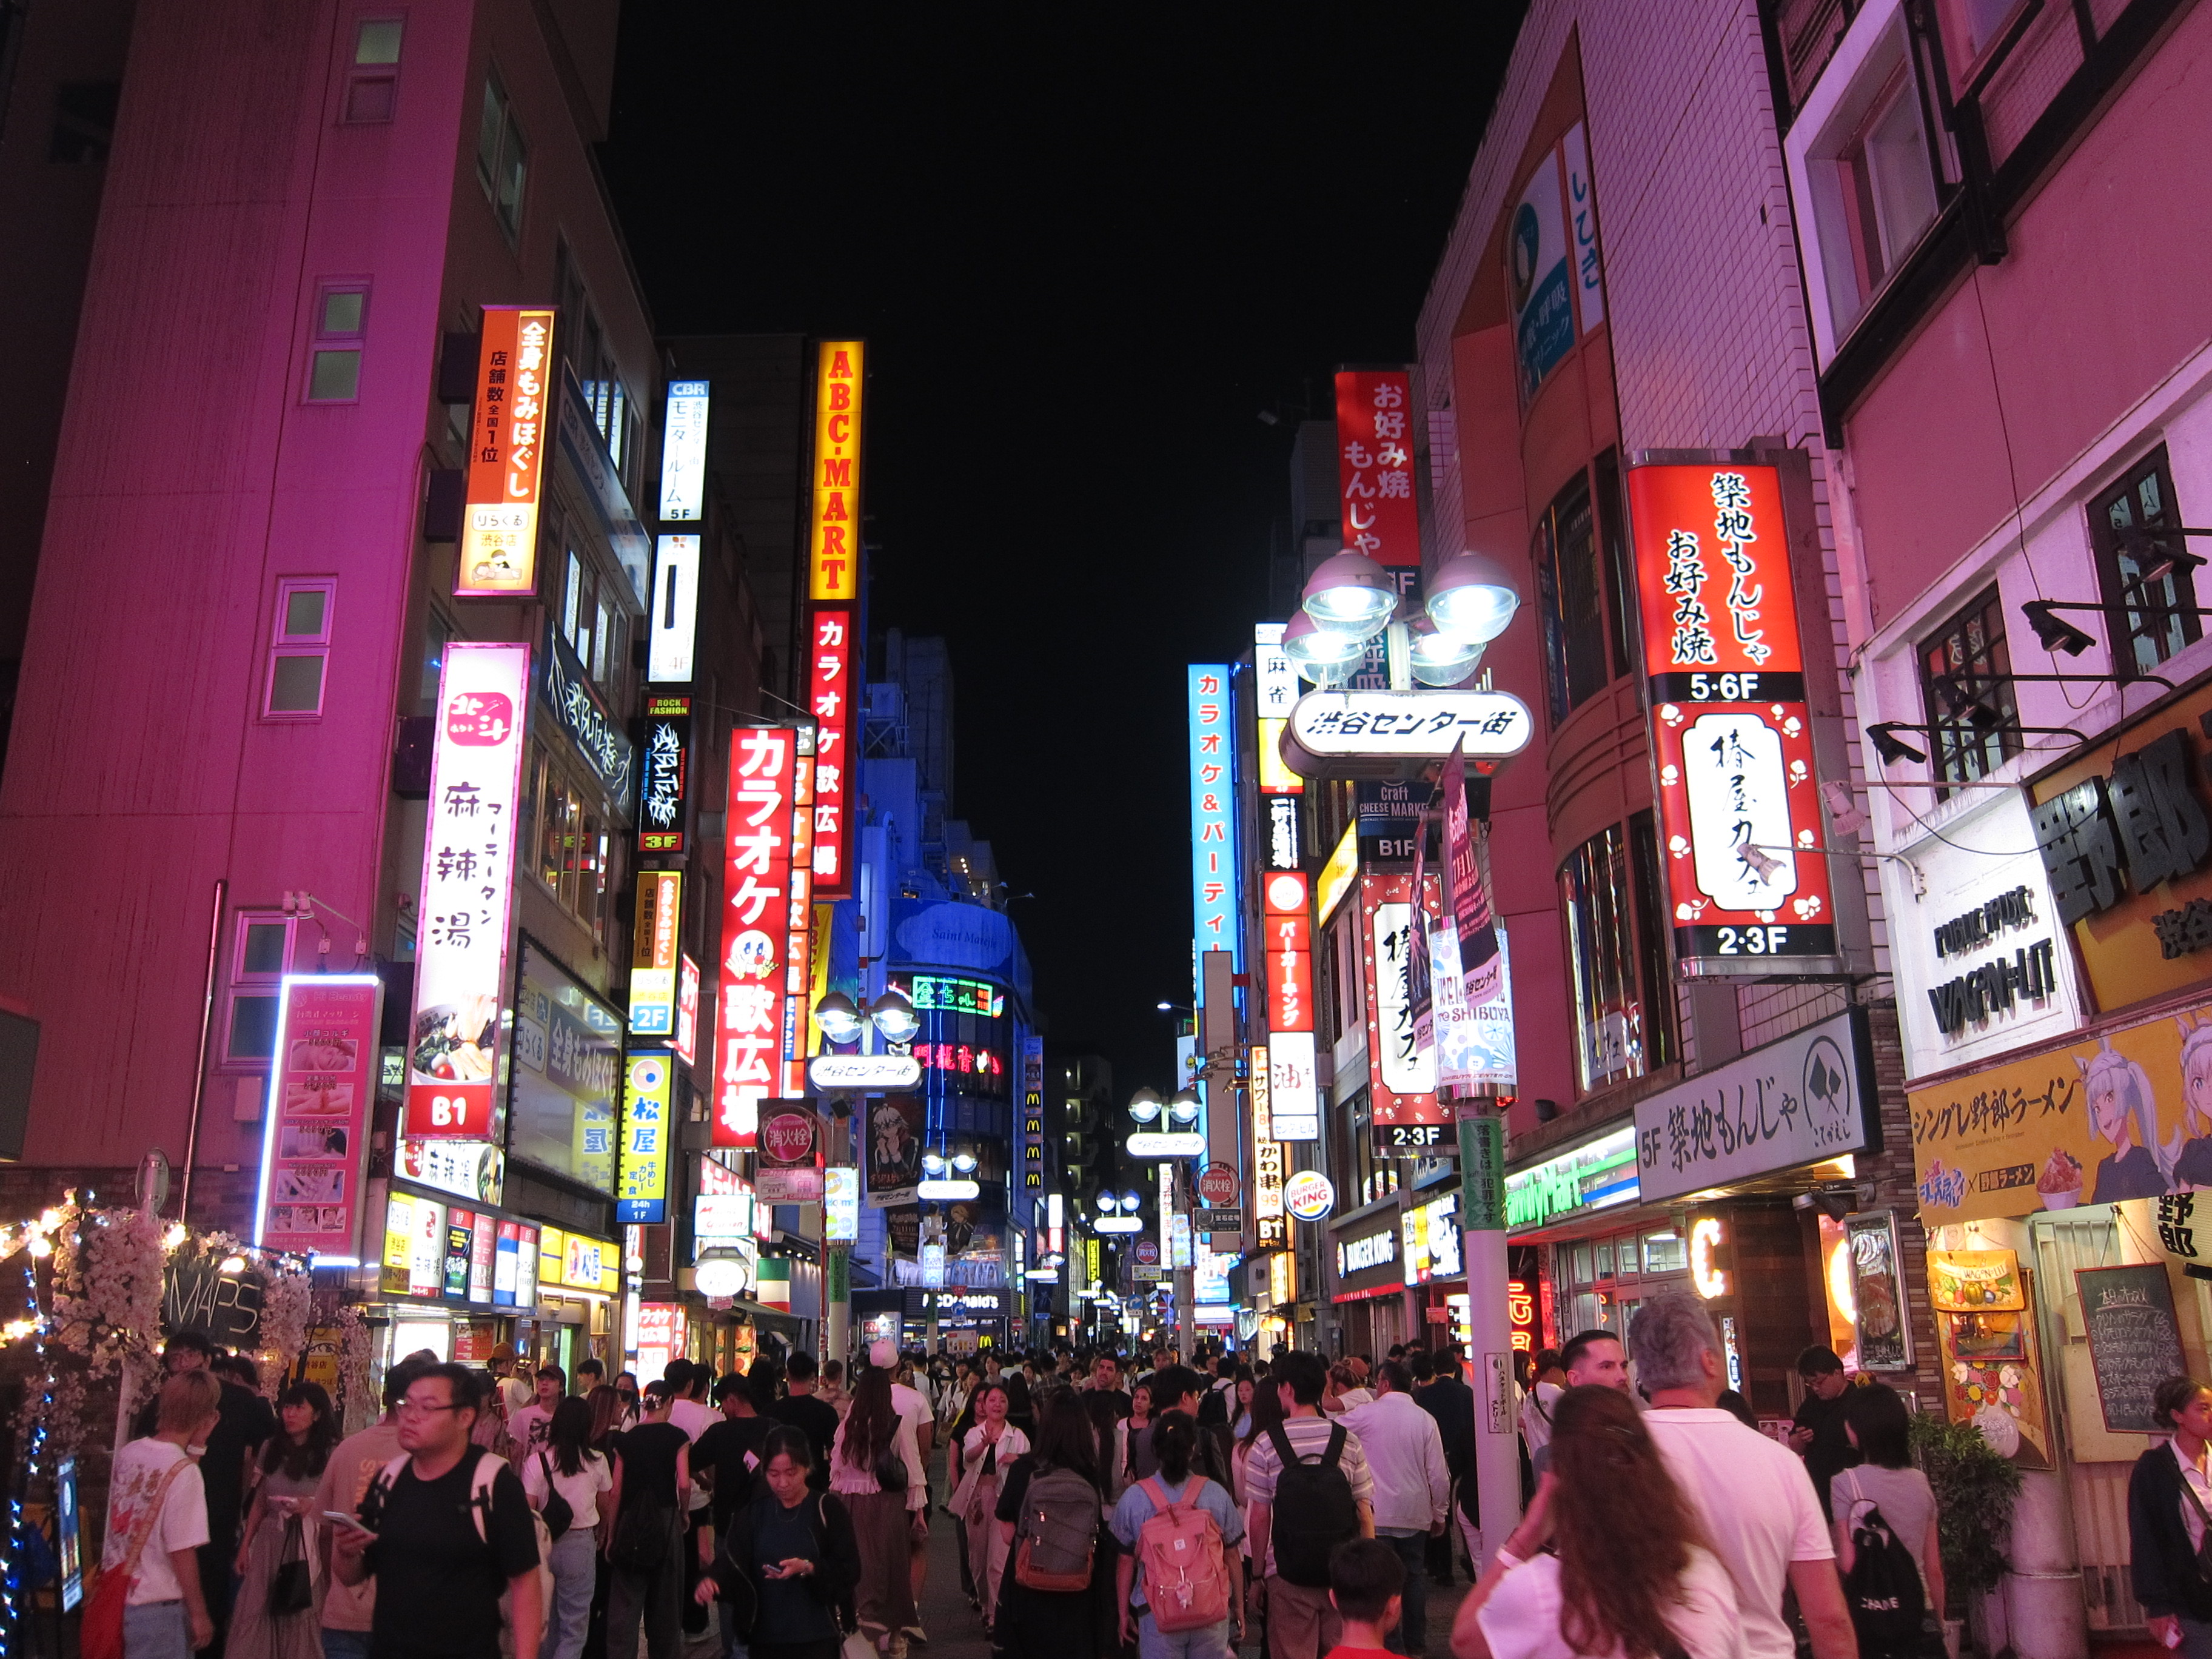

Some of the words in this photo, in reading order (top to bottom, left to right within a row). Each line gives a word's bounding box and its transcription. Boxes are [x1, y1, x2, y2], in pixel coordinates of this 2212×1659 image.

[481, 350, 508, 463] 店舗数全国1位
[508, 321, 547, 498] 全身もみほぐし
[672, 383, 705, 396] CBR
[666, 400, 688, 503] モニタールーム
[1373, 383, 1411, 500] お好み焼
[821, 350, 853, 590] ABC-MART
[477, 514, 523, 527] りらくる
[670, 508, 691, 520] 5F
[1344, 440, 1382, 557] もんじゃ
[480, 534, 517, 548] 渋谷店
[1710, 472, 1772, 665] 築地もんじゃ
[1665, 529, 1717, 665] お好み焼
[1267, 656, 1288, 705] 麻雀
[1306, 711, 1518, 736] 渋谷センター街
[813, 620, 843, 876] カラオケ歌広場
[1359, 802, 1389, 814] CHEESE
[1380, 786, 1409, 801] Craft
[481, 803, 501, 924] マーラータン
[644, 836, 677, 849] 3F
[431, 782, 481, 949] 麻辣湯
[642, 888, 654, 957] 店舗数全国1位
[657, 879, 675, 966] 全身もみほぐし
[1934, 907, 1989, 958] PUBLIC
[1278, 922, 1300, 1026] バーガーキング
[637, 1008, 666, 1027] 2F
[1452, 1007, 1511, 1022] SHIBUYA
[551, 1018, 615, 1103] 全身もみほぐし
[816, 1065, 914, 1078] 渋谷センター街
[431, 1096, 467, 1126] B1
[631, 1097, 660, 1154] 松屋
[1641, 1127, 1661, 1169] 5F
[1667, 1076, 1798, 1173] 築地もんじゃ
[1812, 1118, 1851, 1148] こてがえし
[1913, 1078, 2074, 1145] シングレ野郎ラーメン
[768, 1128, 808, 1147] 消火栓
[628, 1170, 637, 1195] 定食
[638, 1165, 647, 1191] カレー
[646, 1161, 656, 1188] 牛めし
[1202, 1179, 1232, 1193] 消火栓
[1290, 1181, 1326, 1197] BURGER
[631, 1201, 650, 1209] 24h
[634, 1211, 647, 1220] 1F
[1292, 1191, 1328, 1212] KING
[2157, 1191, 2198, 1258] 野郎
[1347, 1236, 1374, 1273] BURGER
[1373, 1229, 1394, 1266] KING
[169, 1267, 261, 1333] MAPS
